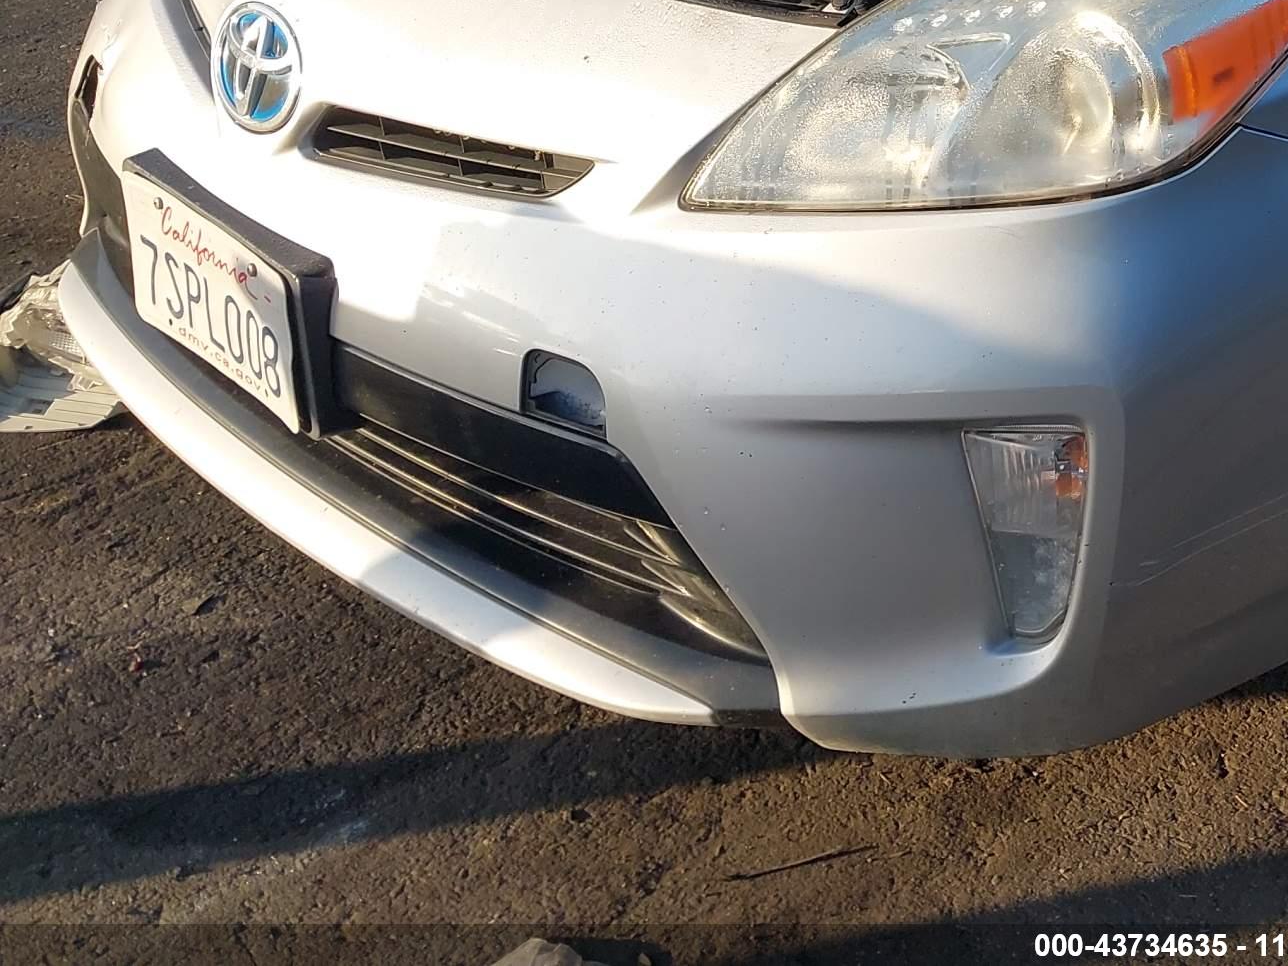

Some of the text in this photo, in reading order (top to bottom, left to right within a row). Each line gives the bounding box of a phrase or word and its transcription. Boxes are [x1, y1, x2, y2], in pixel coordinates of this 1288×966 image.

[160, 206, 250, 285] California
[140, 234, 281, 399] 7SPL008
[178, 326, 261, 391] dmv.ca.gov
